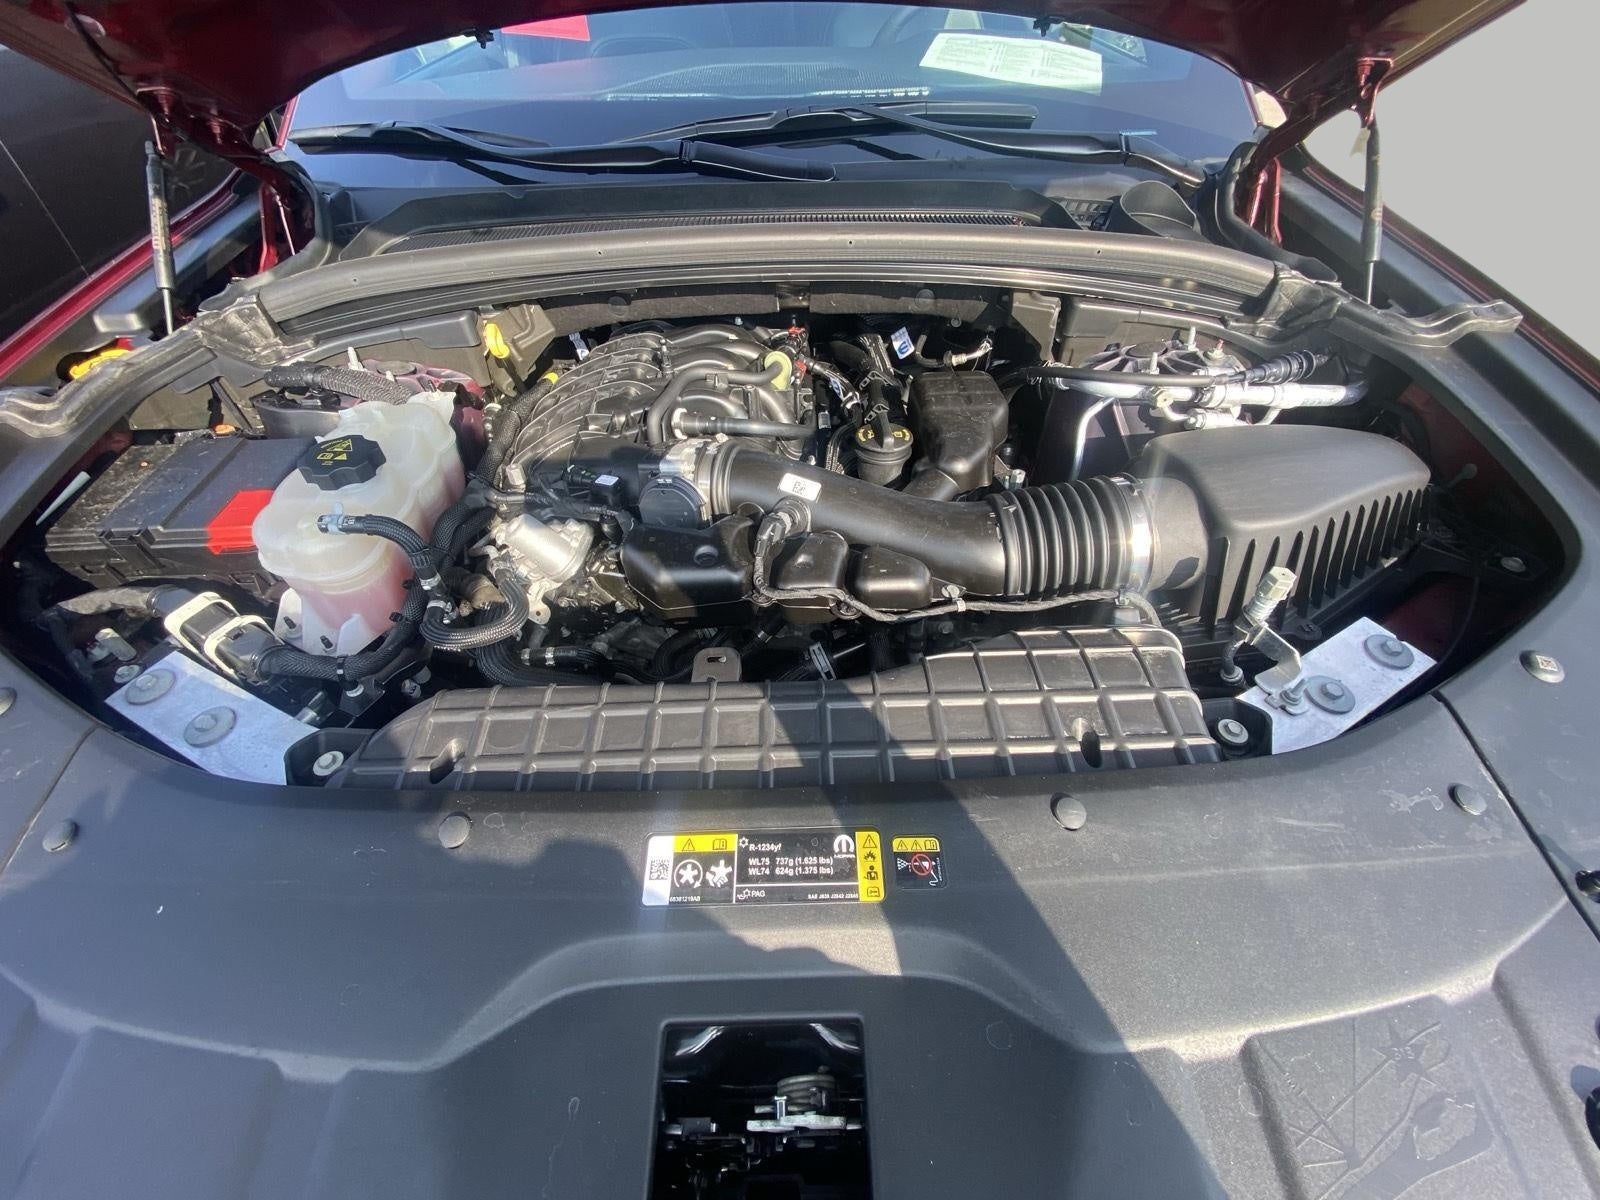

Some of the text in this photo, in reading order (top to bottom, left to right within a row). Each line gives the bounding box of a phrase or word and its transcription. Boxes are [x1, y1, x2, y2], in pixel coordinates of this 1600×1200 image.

[749, 843, 782, 853] R-1234yf
[748, 856, 834, 867] WL75 737g (1.625 lbs)
[748, 866, 834, 876] WL74 624g (1.375 lbs)
[751, 890, 766, 898] PAG
